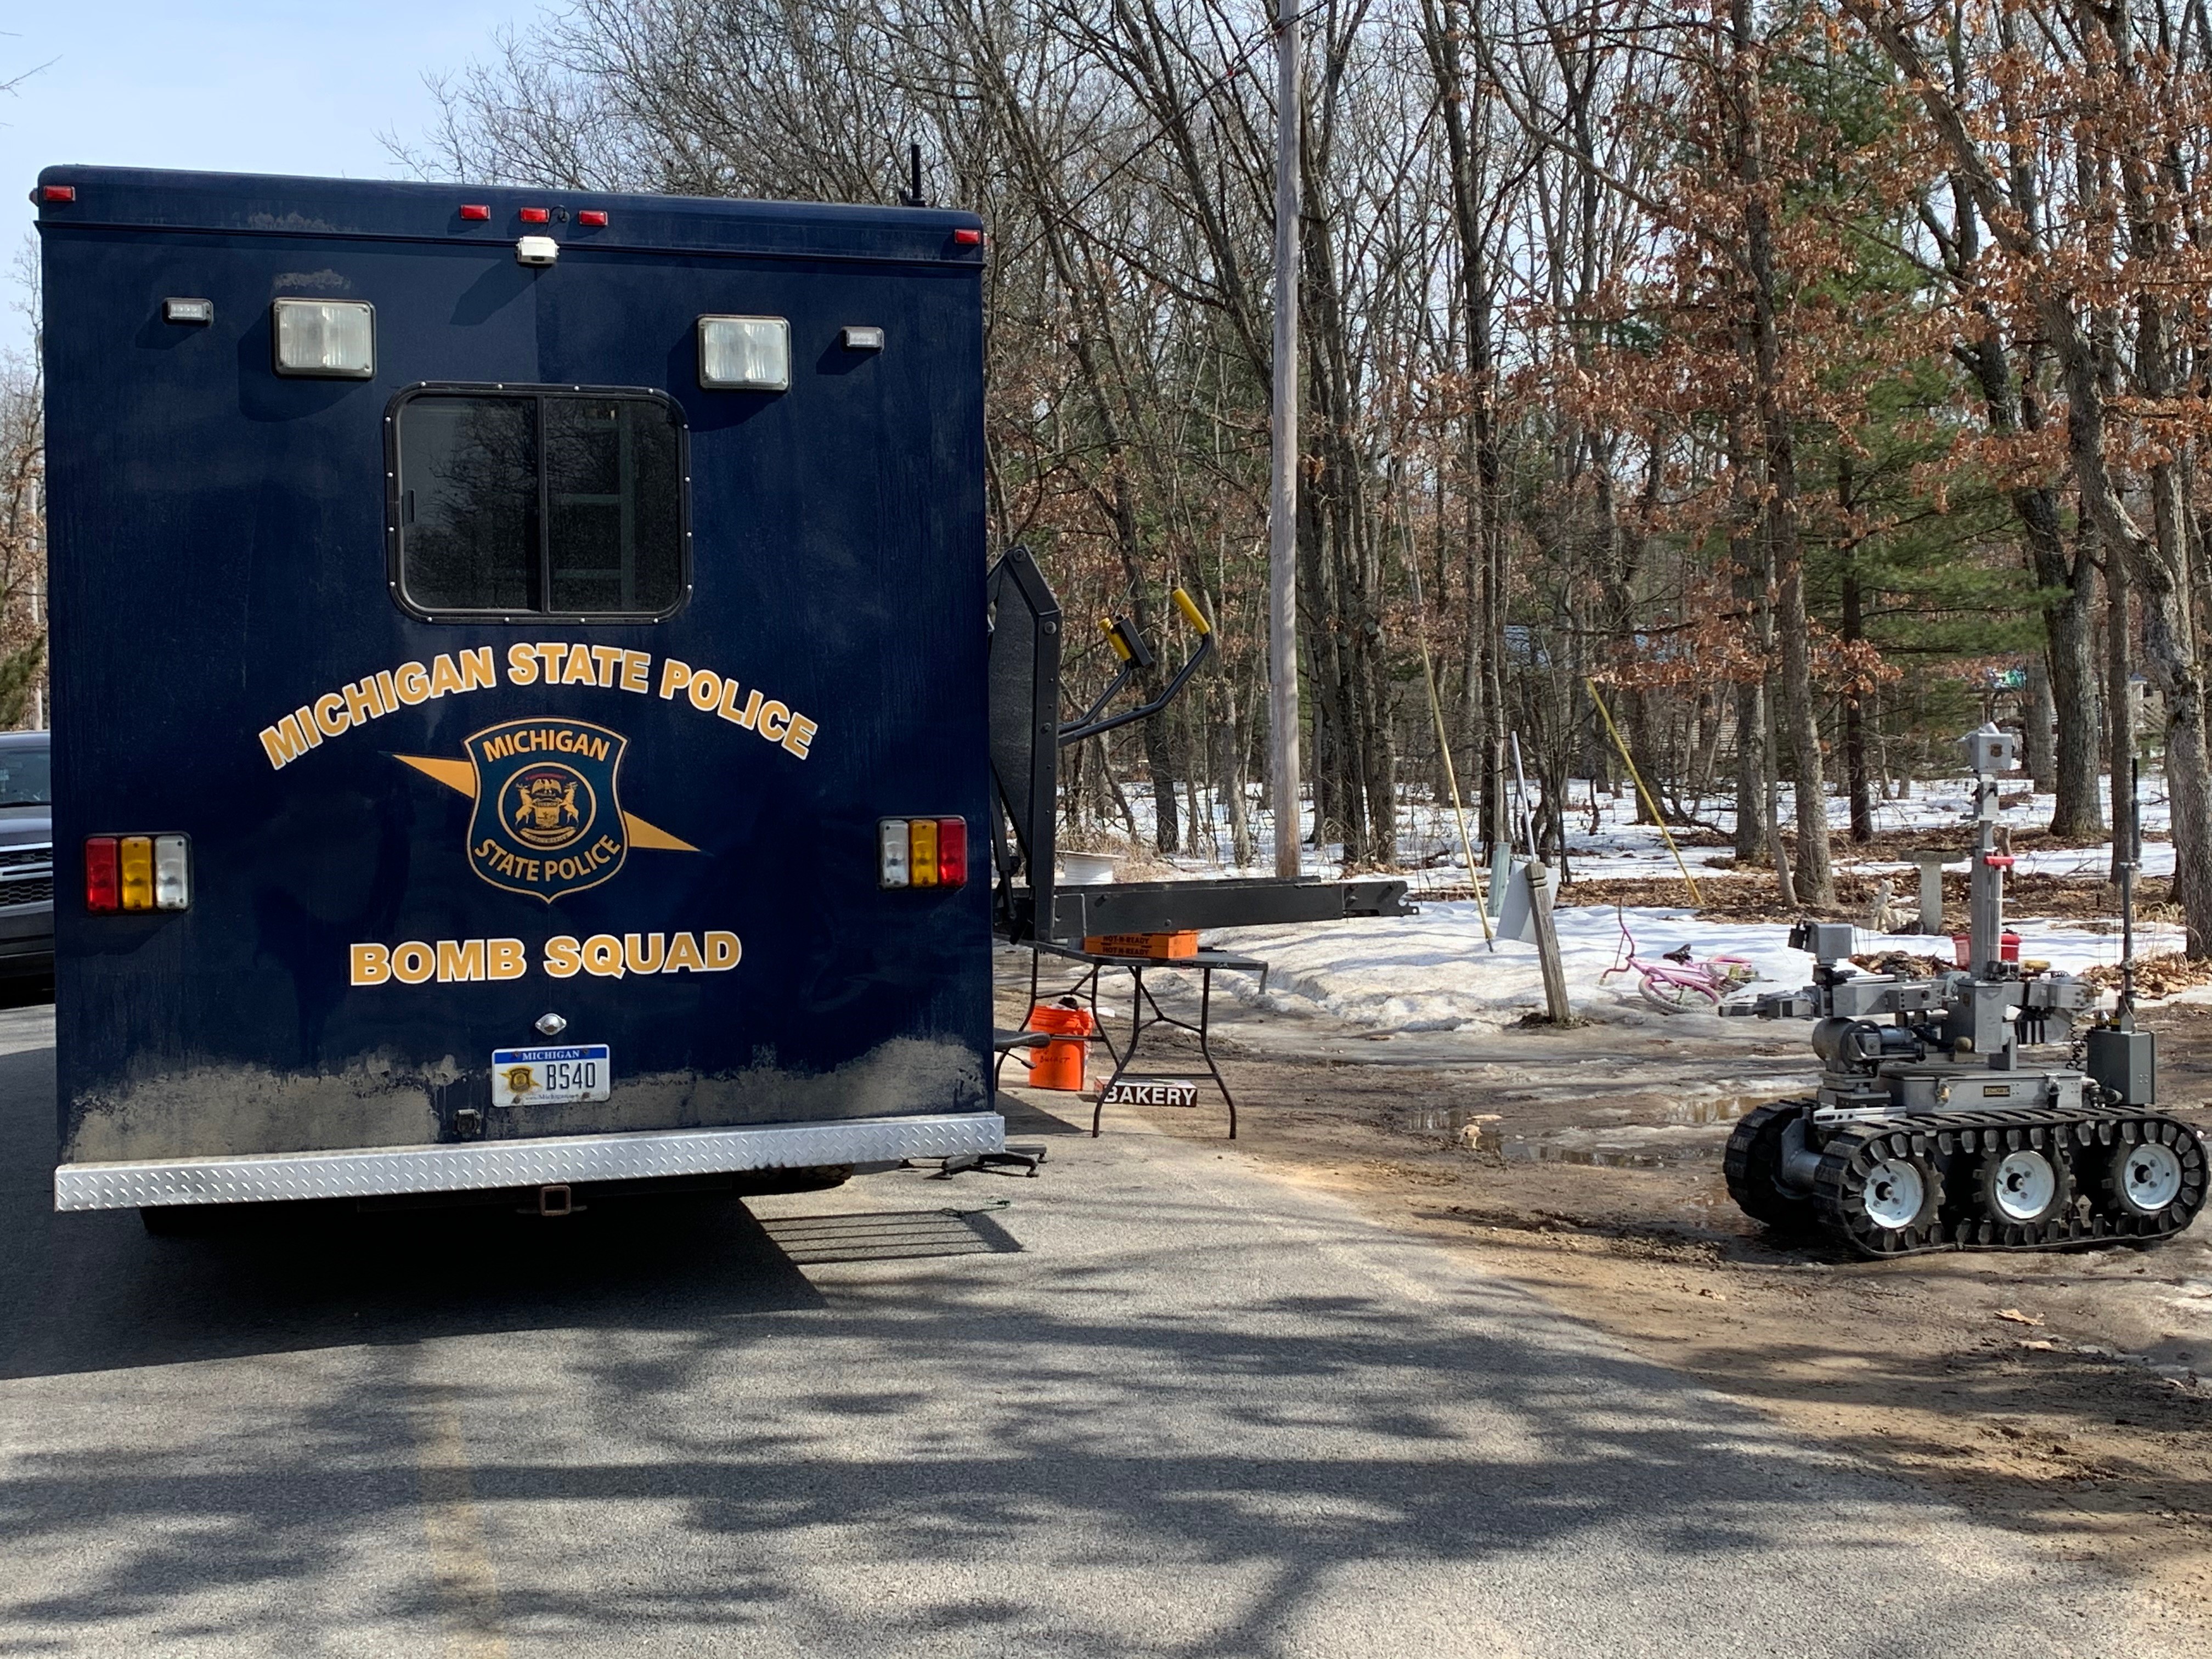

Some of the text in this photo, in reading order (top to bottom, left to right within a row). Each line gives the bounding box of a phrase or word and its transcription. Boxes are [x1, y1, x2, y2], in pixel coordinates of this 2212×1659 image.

[259, 642, 818, 770] MICHIGAN STATE POLICE
[483, 730, 610, 763] MICHIGAN
[475, 834, 622, 882] STATE POLICE
[350, 931, 742, 986] BOMB SQUAD
[522, 1050, 580, 1061] MICHIGAN
[546, 1062, 596, 1091] BS40
[1104, 1086, 1197, 1106] BAKERY
